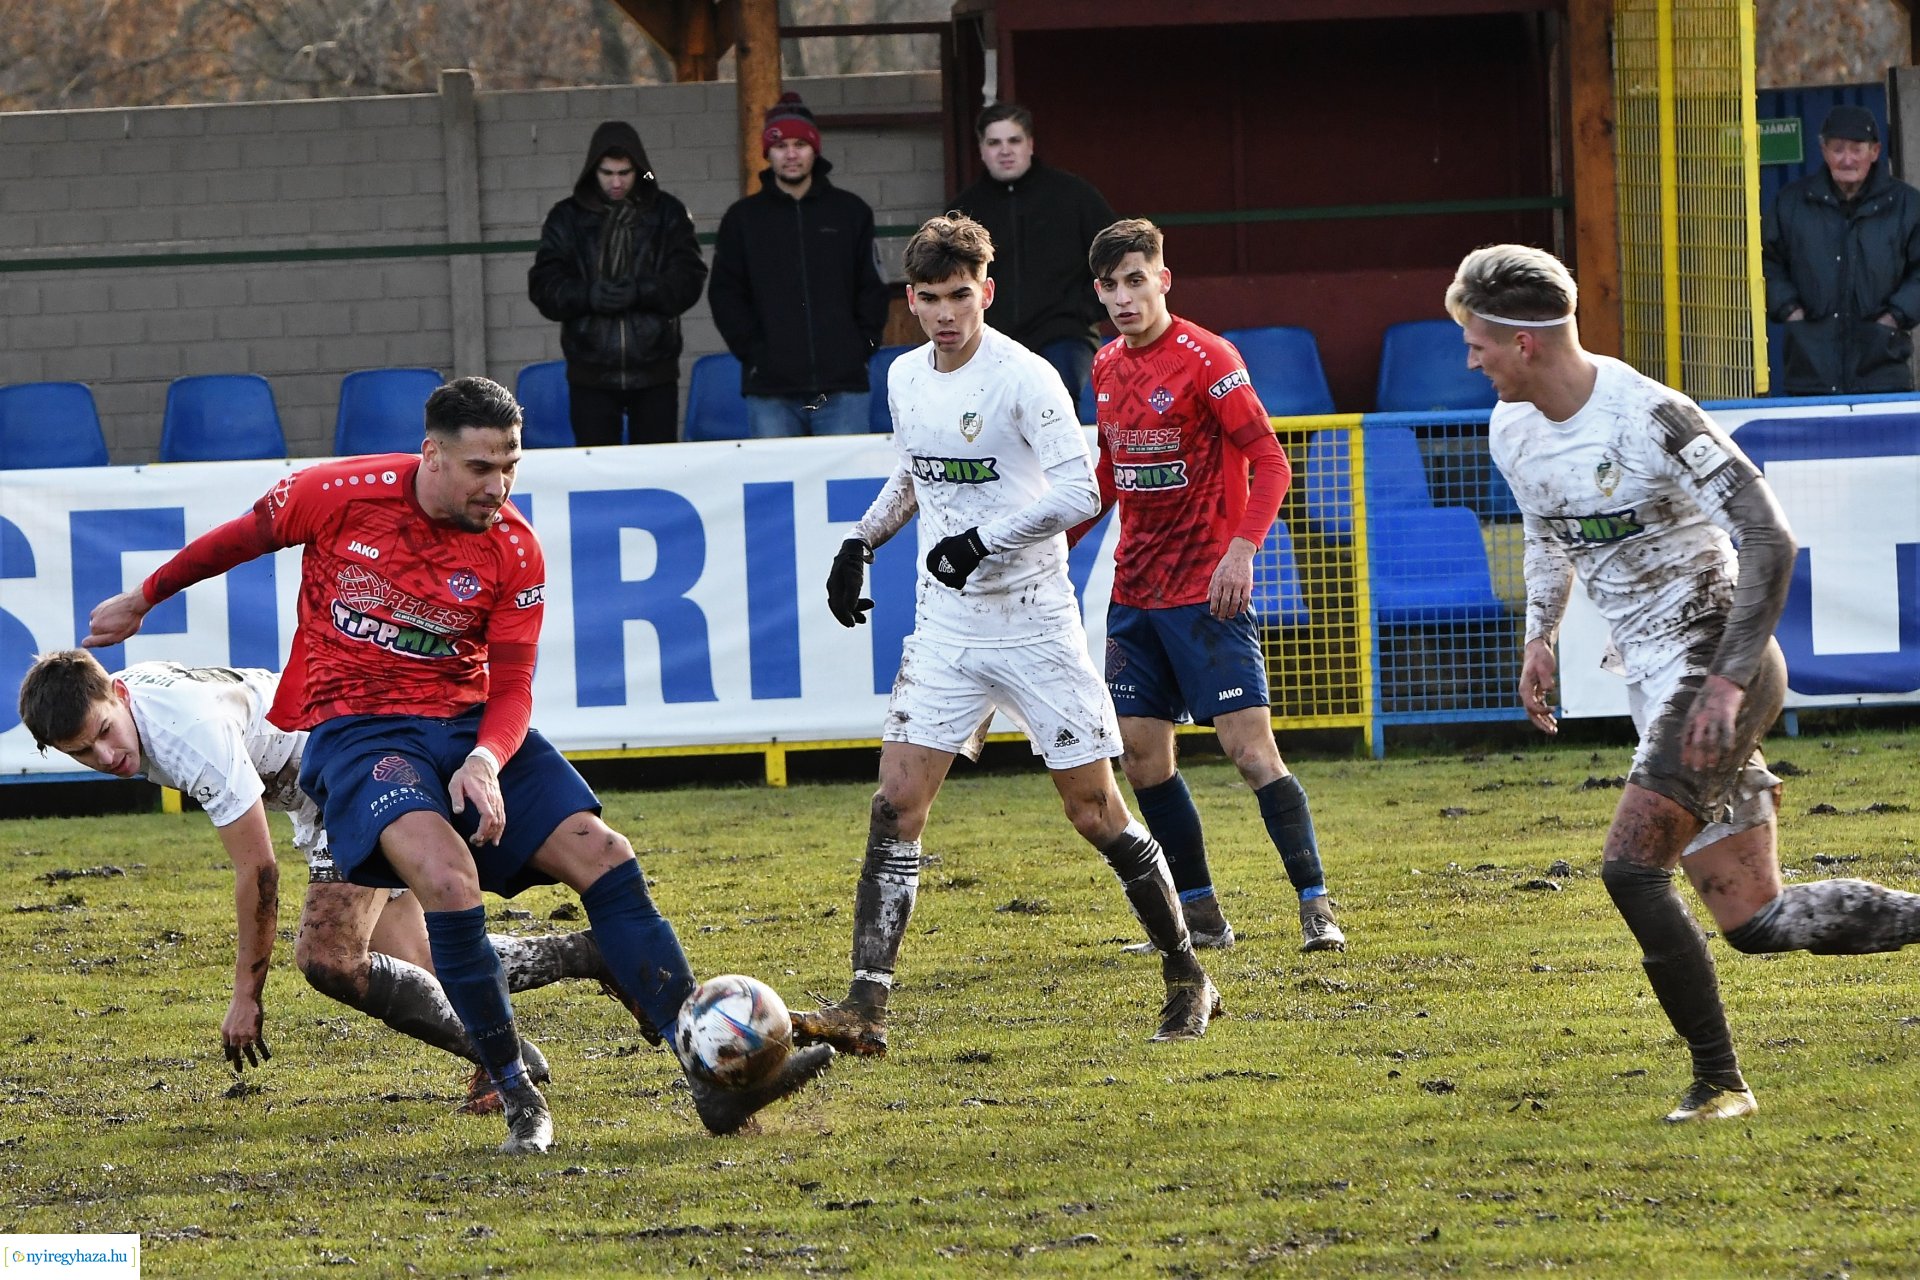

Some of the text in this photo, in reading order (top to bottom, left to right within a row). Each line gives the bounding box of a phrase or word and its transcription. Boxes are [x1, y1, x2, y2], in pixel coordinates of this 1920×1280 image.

[348, 541, 379, 559] JAKO
[1218, 688, 1243, 701] JAKO
[1054, 738, 1080, 748] adidas
